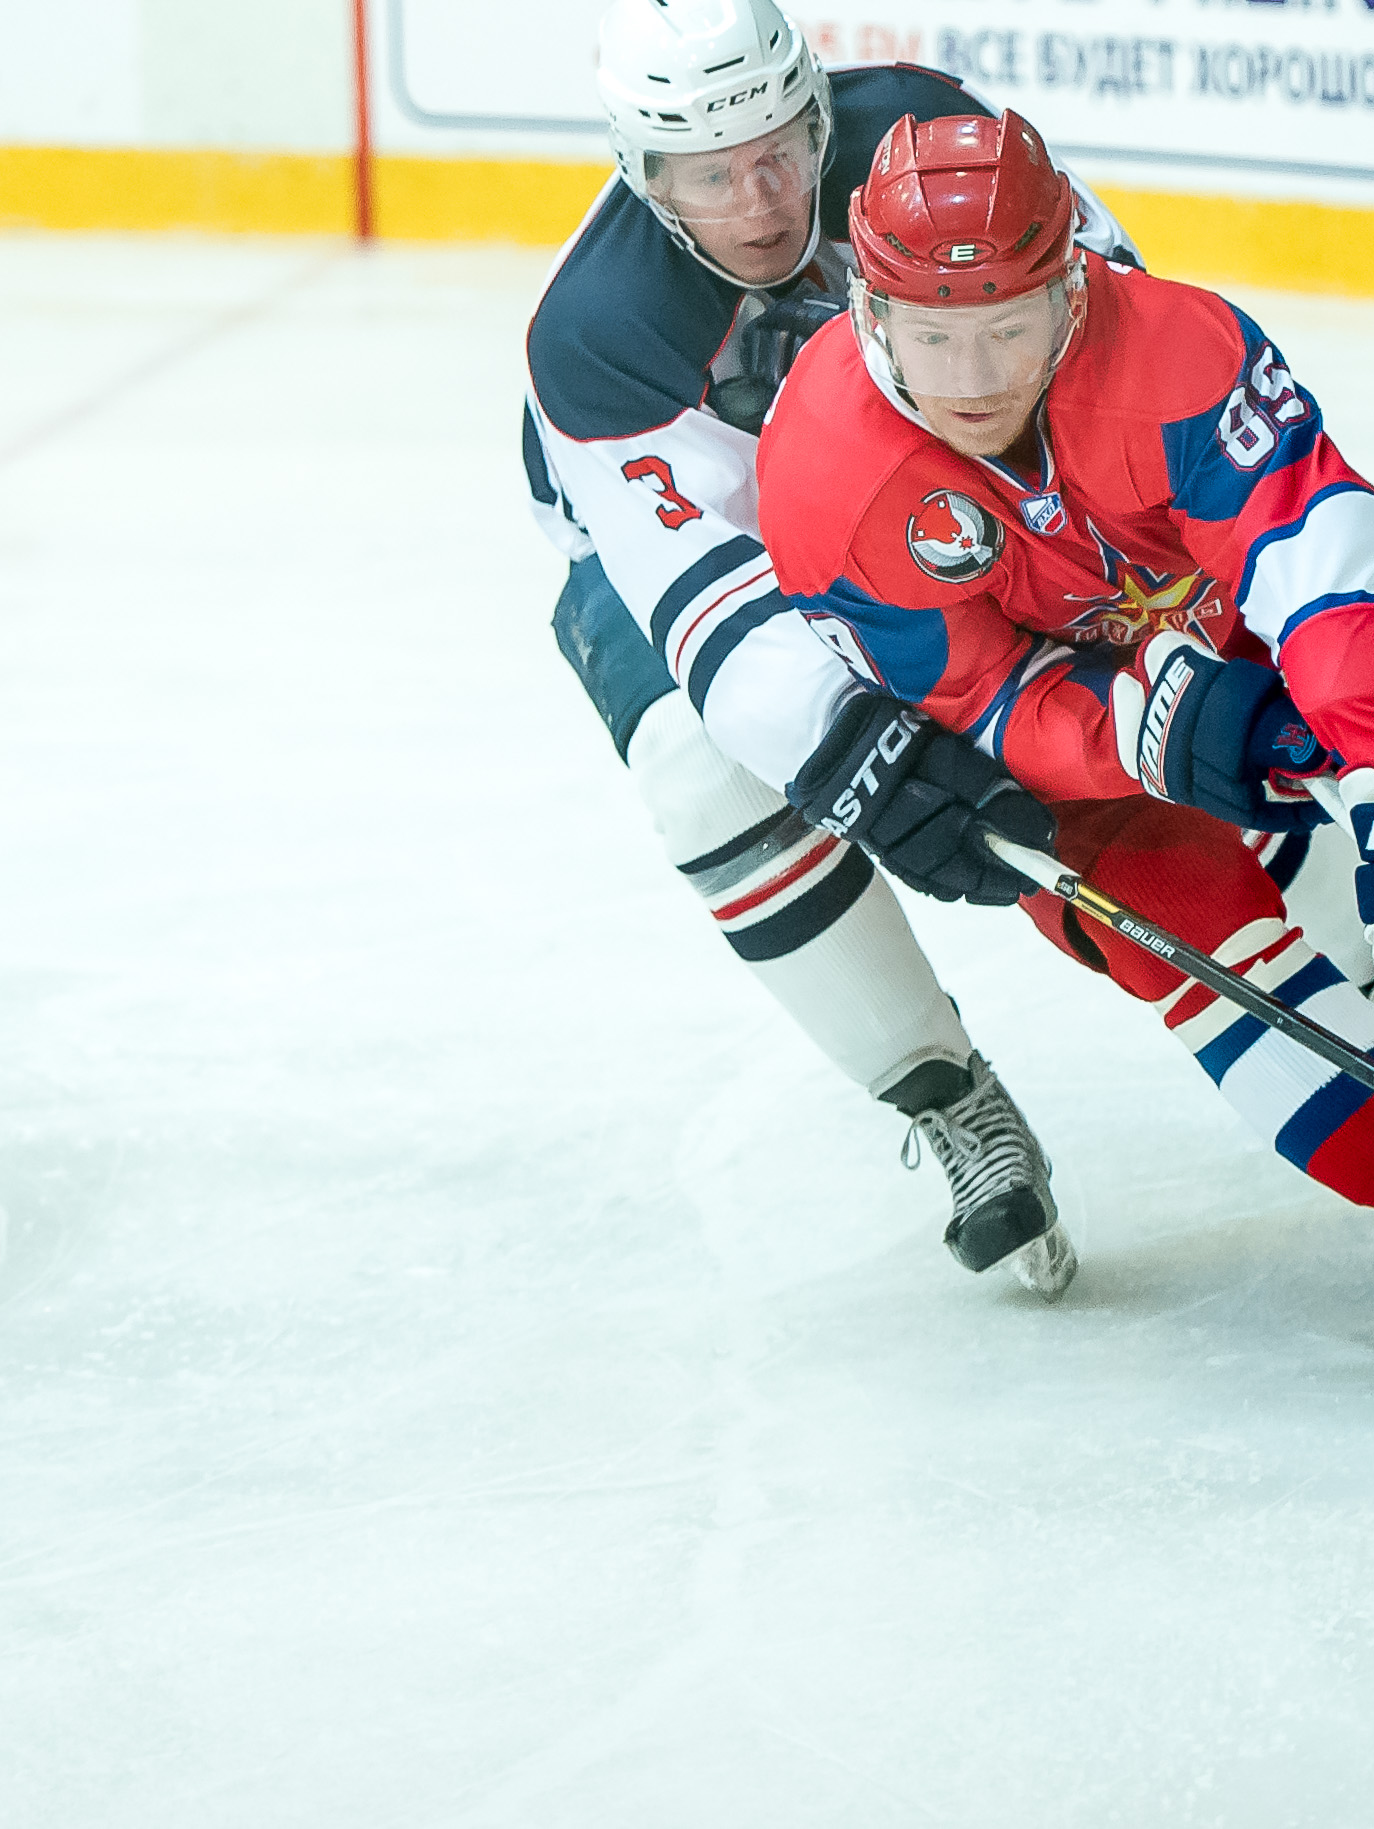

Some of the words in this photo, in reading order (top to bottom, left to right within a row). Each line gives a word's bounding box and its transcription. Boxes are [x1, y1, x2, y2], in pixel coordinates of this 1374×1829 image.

[937, 27, 1018, 86] ВСЕ
[1036, 31, 1175, 102] БУДЕТ
[706, 81, 769, 113] CCM
[620, 455, 704, 531] 3
[1119, 918, 1176, 959] BAUER
